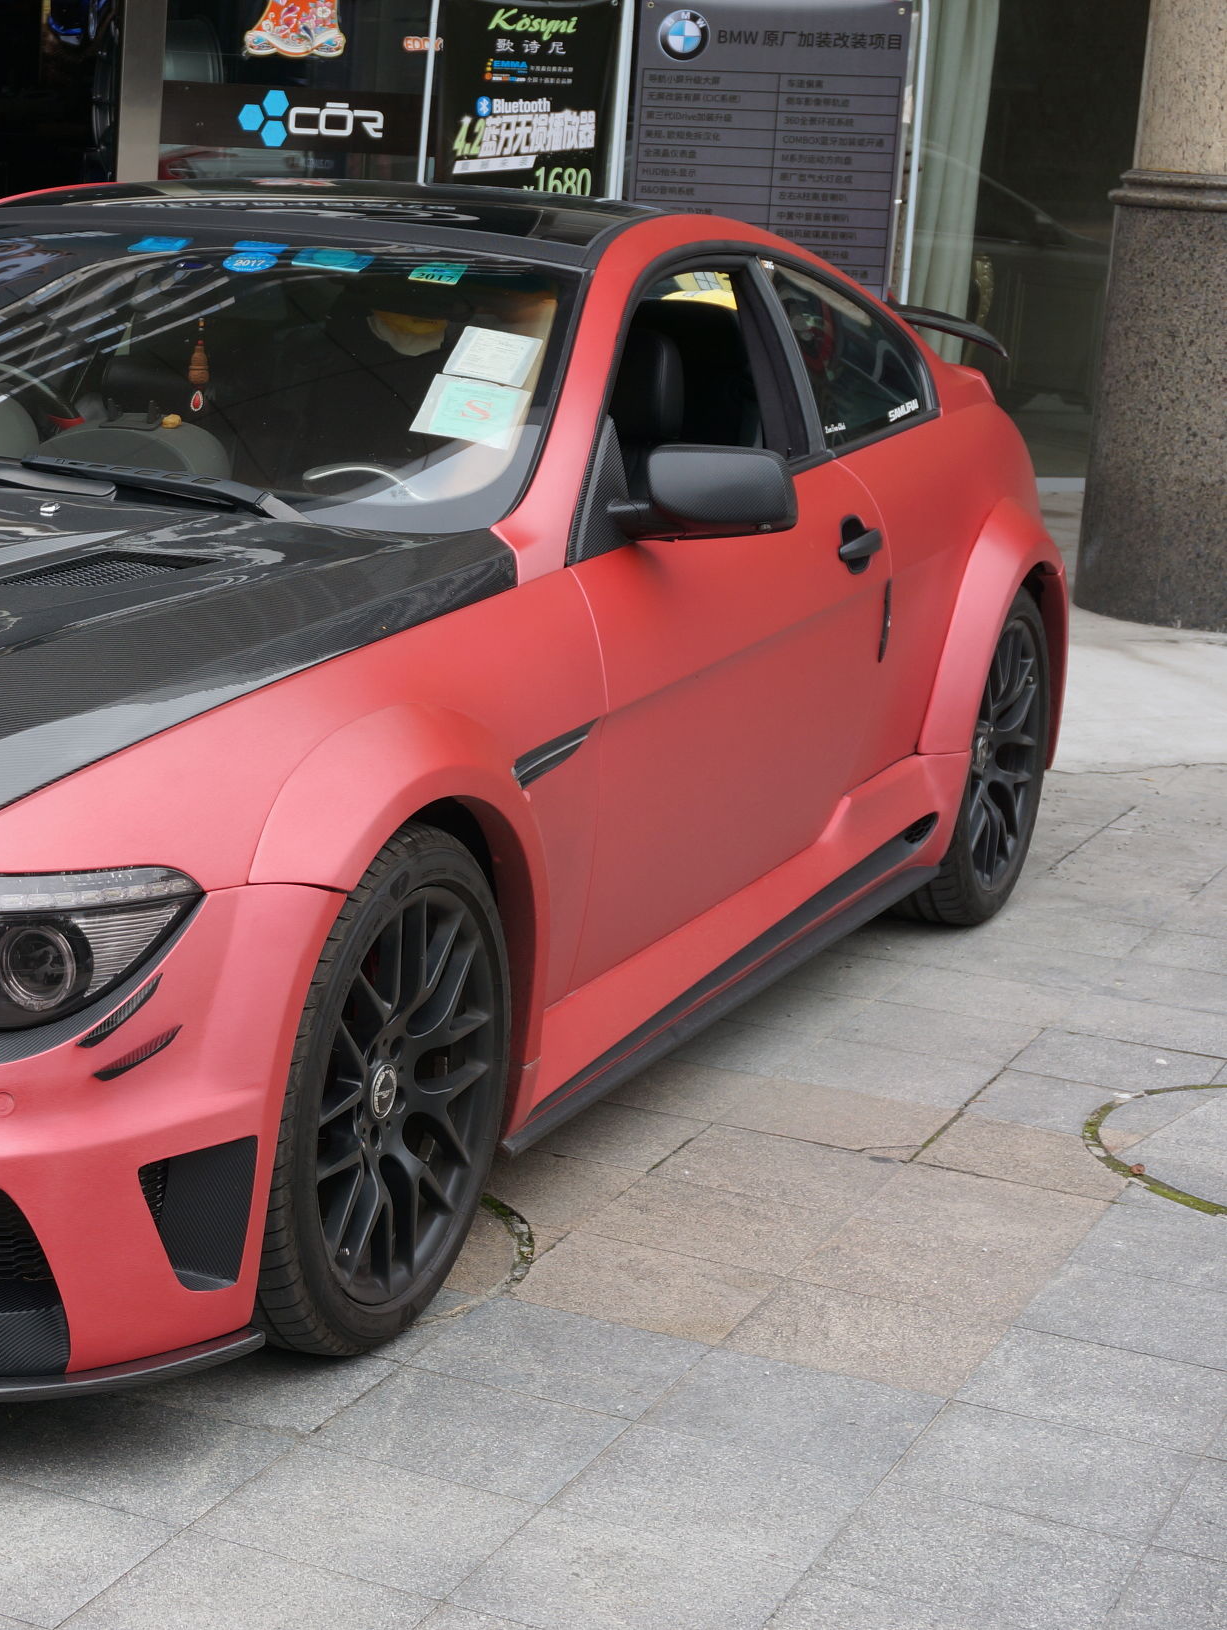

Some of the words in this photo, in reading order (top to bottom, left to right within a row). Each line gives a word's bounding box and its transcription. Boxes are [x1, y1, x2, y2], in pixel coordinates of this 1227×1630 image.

[495, 38, 566, 55] 歌诗尼
[717, 29, 758, 46] BMW
[762, 30, 903, 51] 原厂加装改装项目
[493, 98, 551, 114] Bluetooth
[233, 259, 267, 267] 2017
[415, 272, 455, 283] 2017
[460, 399, 494, 421] S
